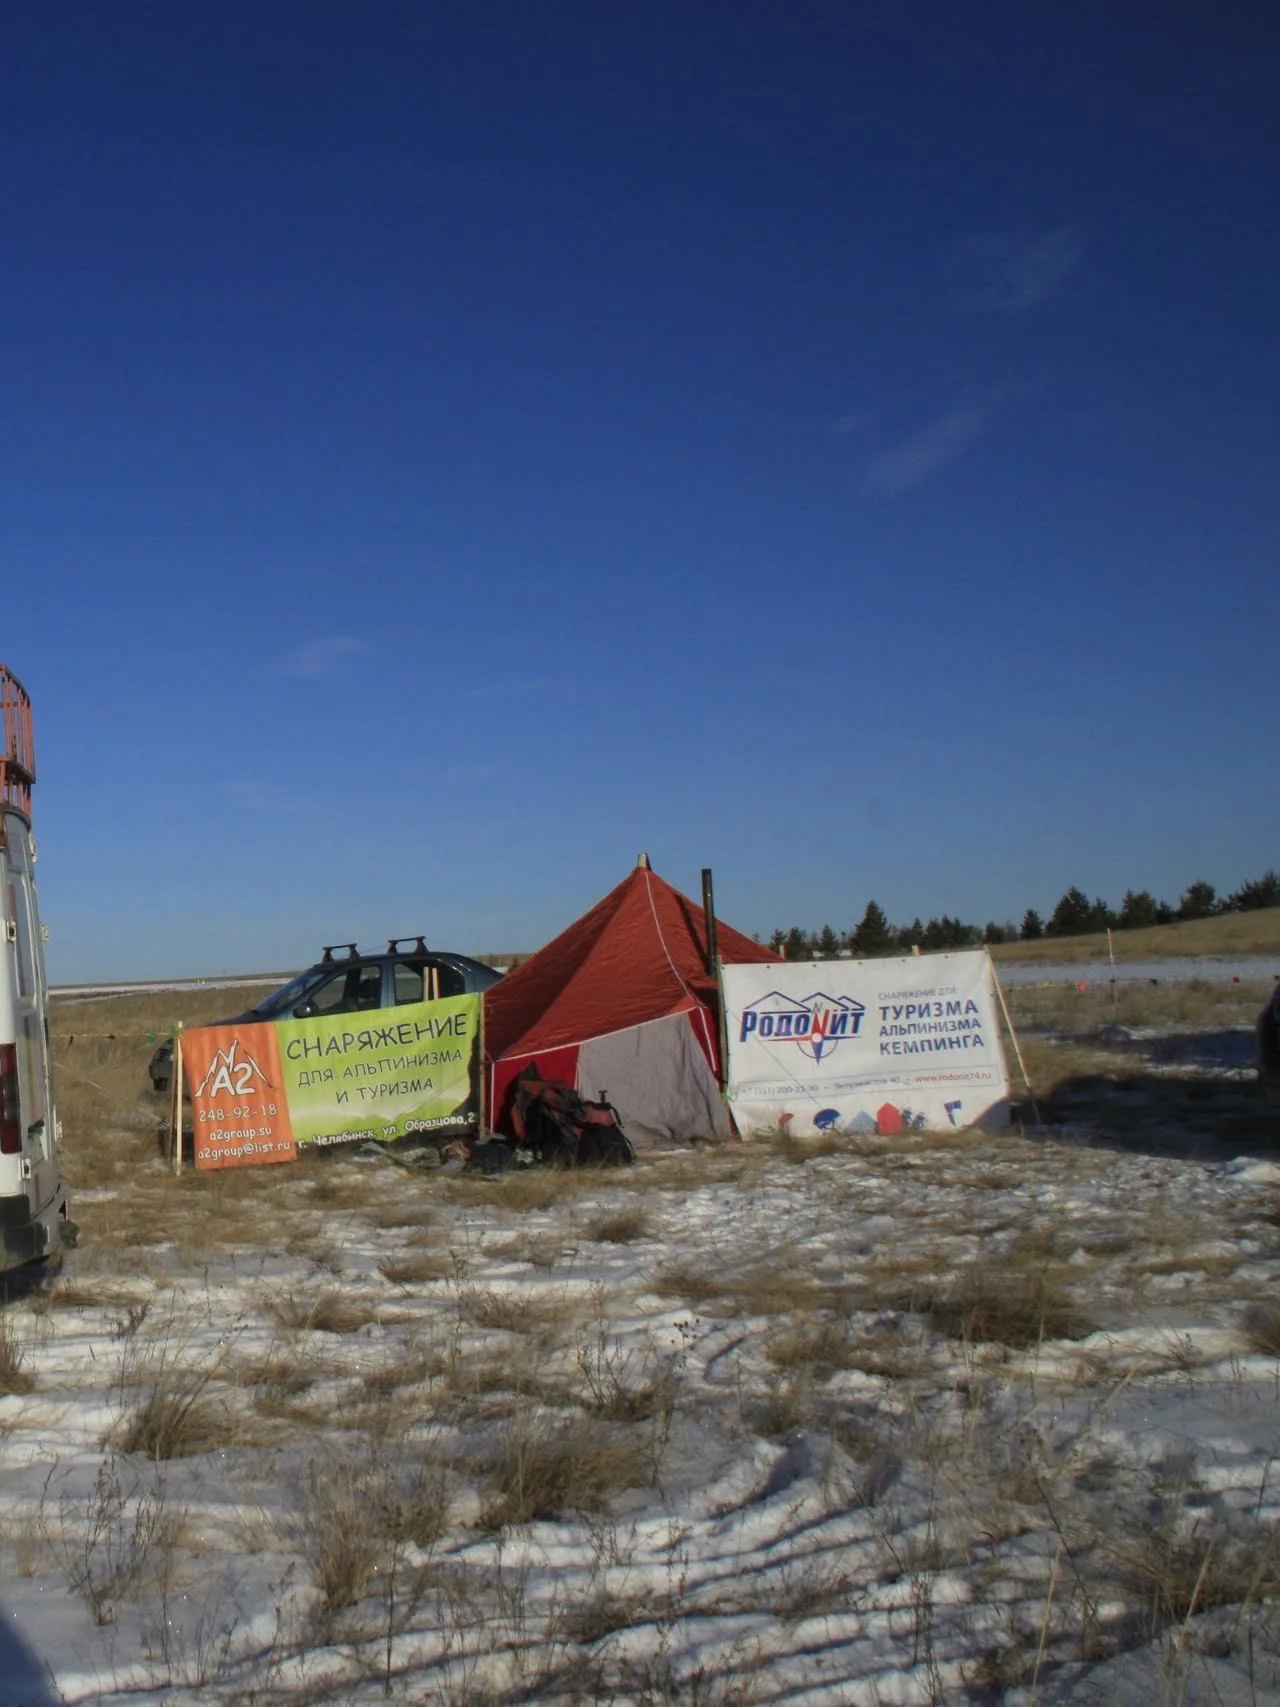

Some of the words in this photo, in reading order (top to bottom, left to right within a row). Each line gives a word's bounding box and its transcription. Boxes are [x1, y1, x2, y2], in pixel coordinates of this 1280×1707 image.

[878, 987, 936, 1001] СНАРЯЖЕНИЕ
[878, 999, 979, 1021] ТУРИЗМА
[286, 1013, 468, 1061] СНАРЯЖЕНИЕ
[880, 1018, 981, 1037] АЛЬПИНИЗМА
[880, 1034, 985, 1056] КЕМПИНГА
[298, 1068, 335, 1089] ДЛЯ
[342, 1049, 463, 1080] АЛЬПИНИЗМА
[336, 1091, 349, 1105] И
[356, 1078, 433, 1101] ТУРИЗМА
[199, 1103, 277, 1122] 248-92-18
[209, 1126, 272, 1142] a2group.su
[382, 1126, 399, 1138] ул.
[198, 1141, 291, 1161] a2group@list.ru
